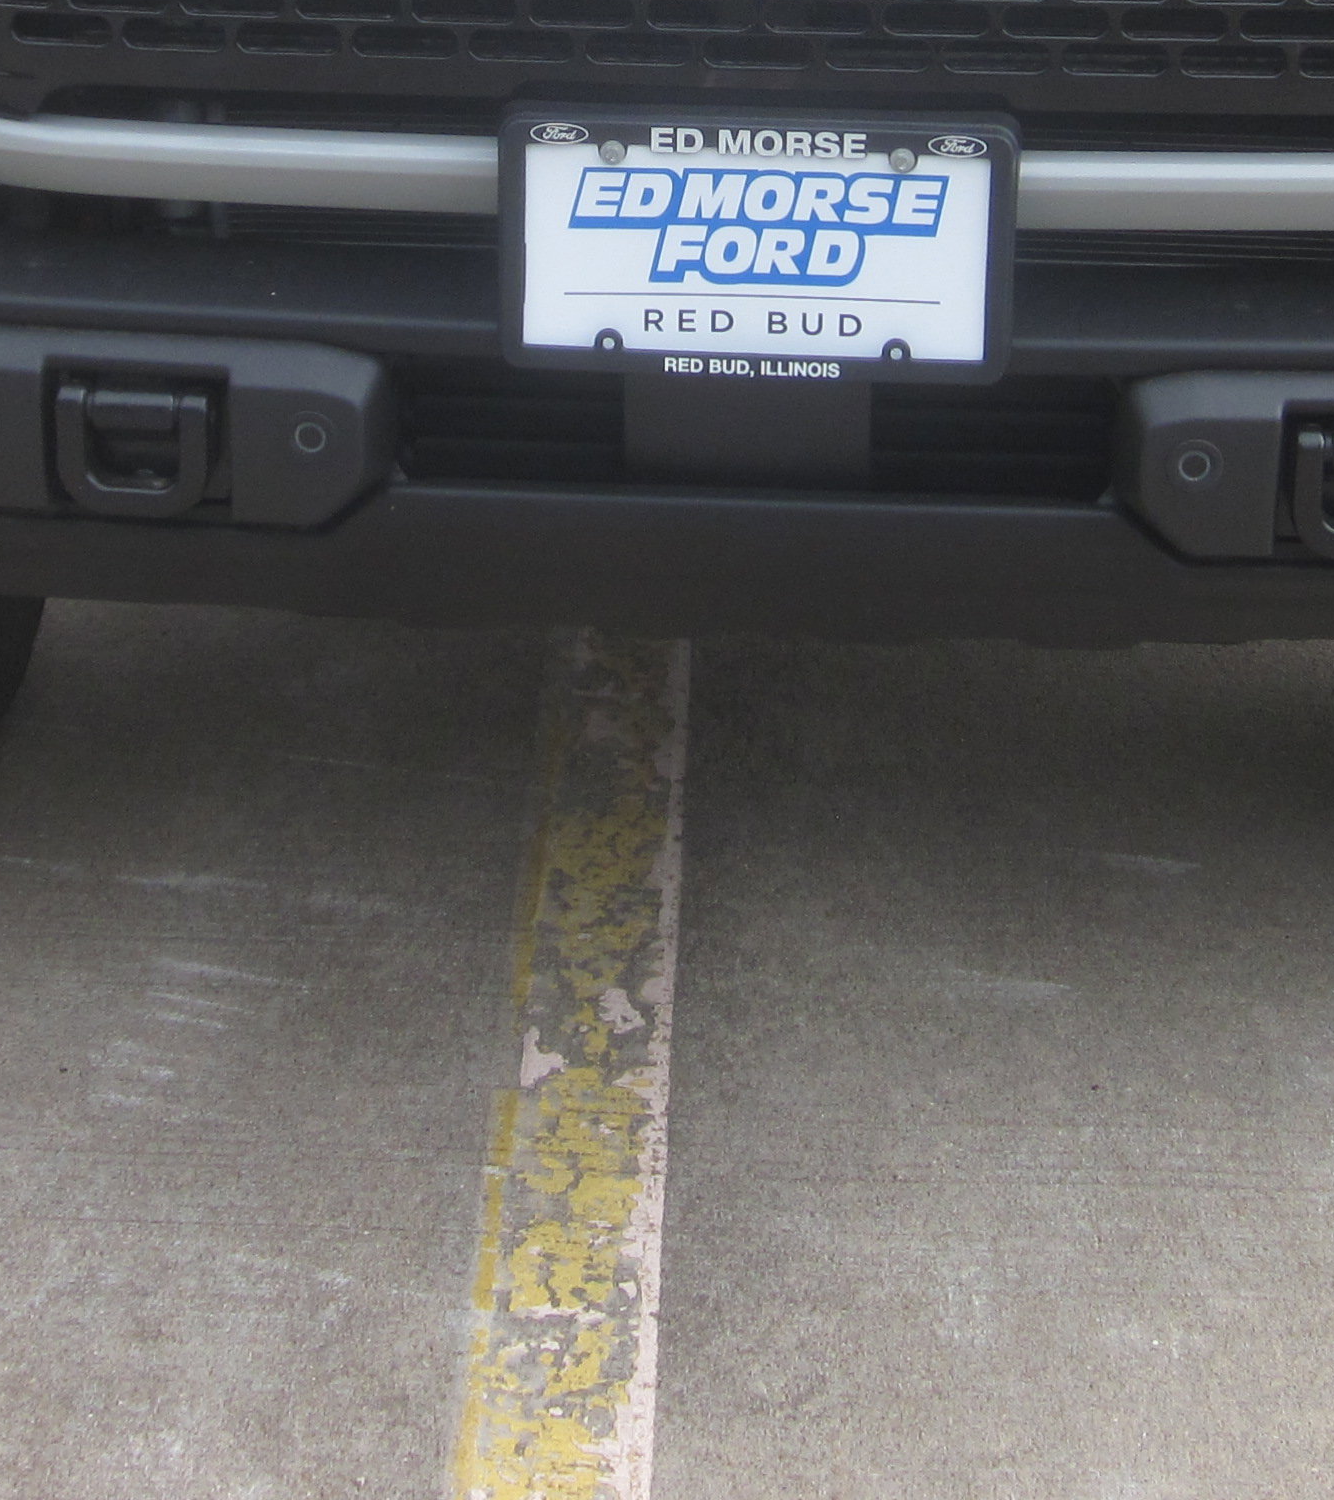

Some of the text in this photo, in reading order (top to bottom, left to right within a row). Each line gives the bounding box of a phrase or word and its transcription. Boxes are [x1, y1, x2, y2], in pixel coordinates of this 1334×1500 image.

[542, 125, 578, 140] Ford
[650, 127, 867, 159] ED MORSE
[940, 138, 976, 153] Ford
[574, 171, 944, 226] ED MORSE
[655, 224, 861, 277] FORD
[643, 308, 863, 338] RED BUD
[664, 356, 841, 379] RED BUD, ILLINOIS
